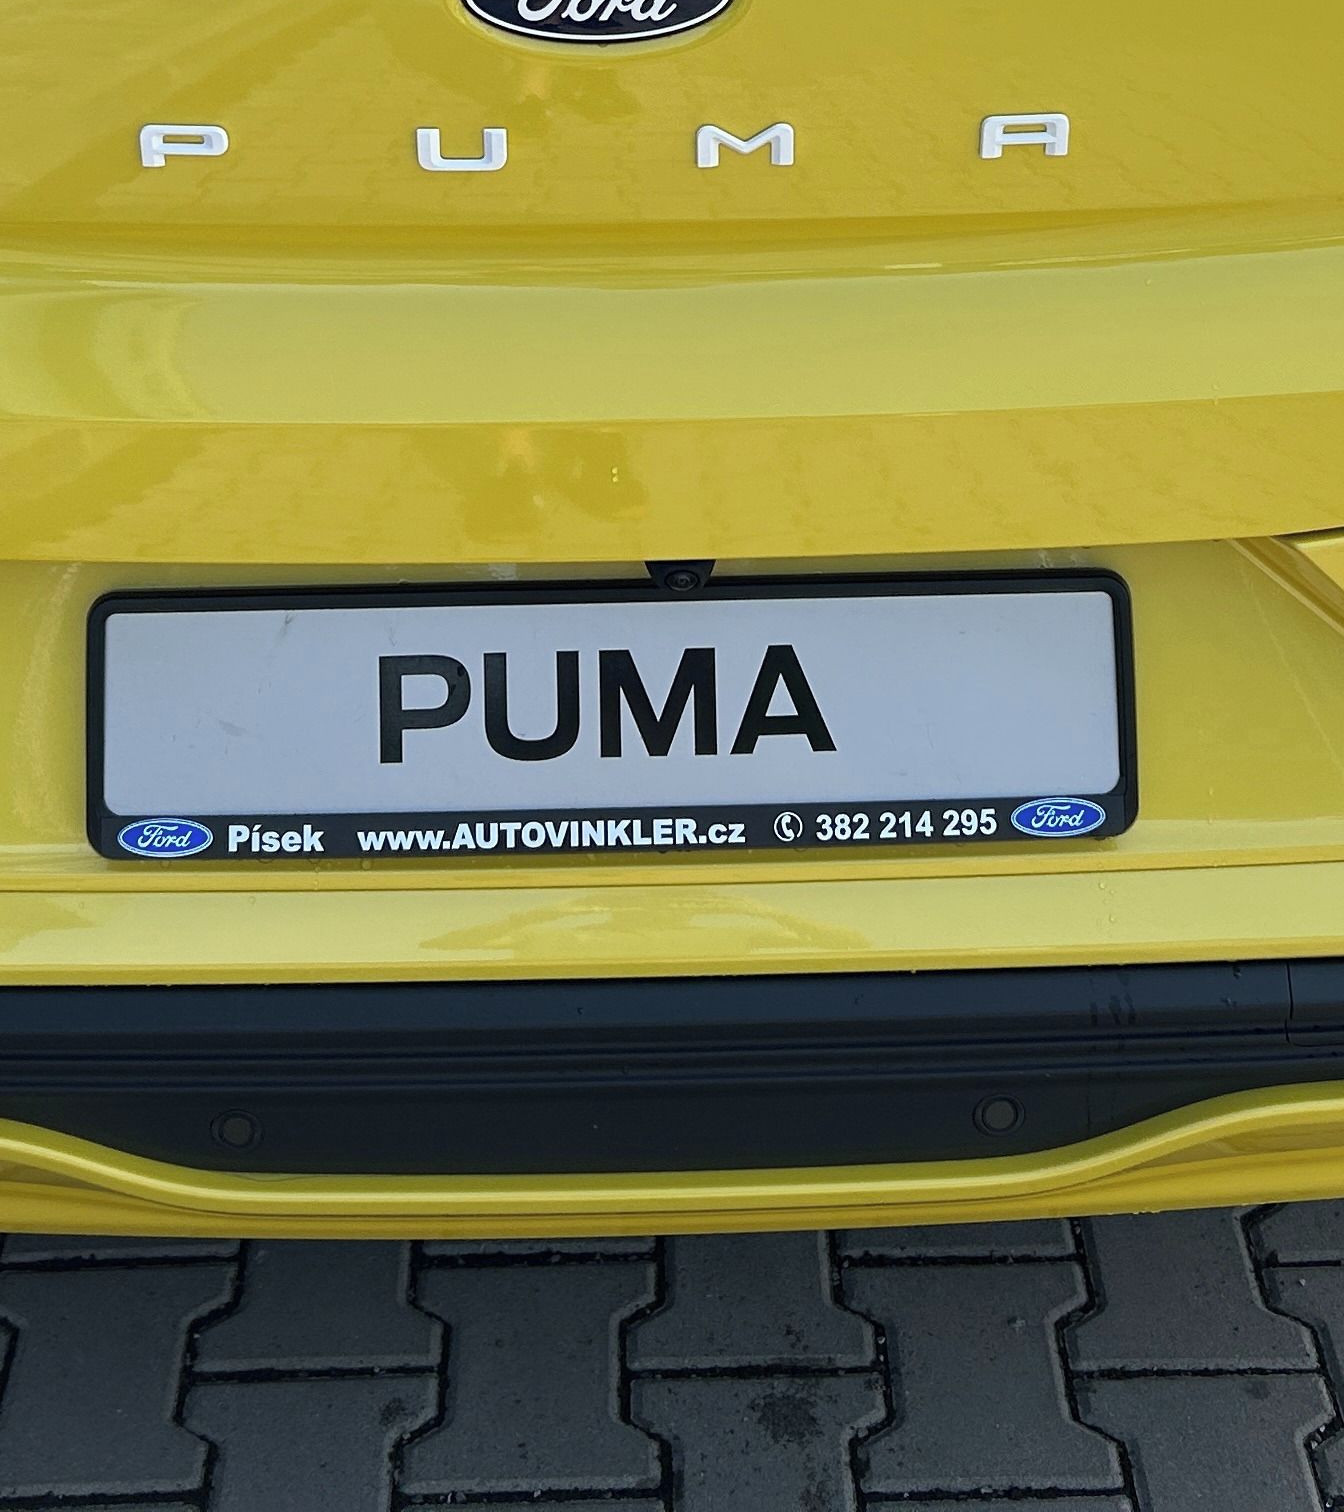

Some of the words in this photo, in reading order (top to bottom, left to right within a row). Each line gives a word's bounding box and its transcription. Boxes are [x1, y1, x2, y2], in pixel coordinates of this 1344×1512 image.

[138, 111, 1071, 173] PUMA
[377, 644, 837, 765] PUMA
[137, 823, 191, 850] Ford
[228, 823, 325, 854] Písek
[357, 817, 747, 852] www.AUTOVINKLER.cz
[815, 812, 870, 841] 382
[879, 811, 934, 839] 214
[942, 808, 997, 837] 295
[1031, 804, 1085, 830] Ford
